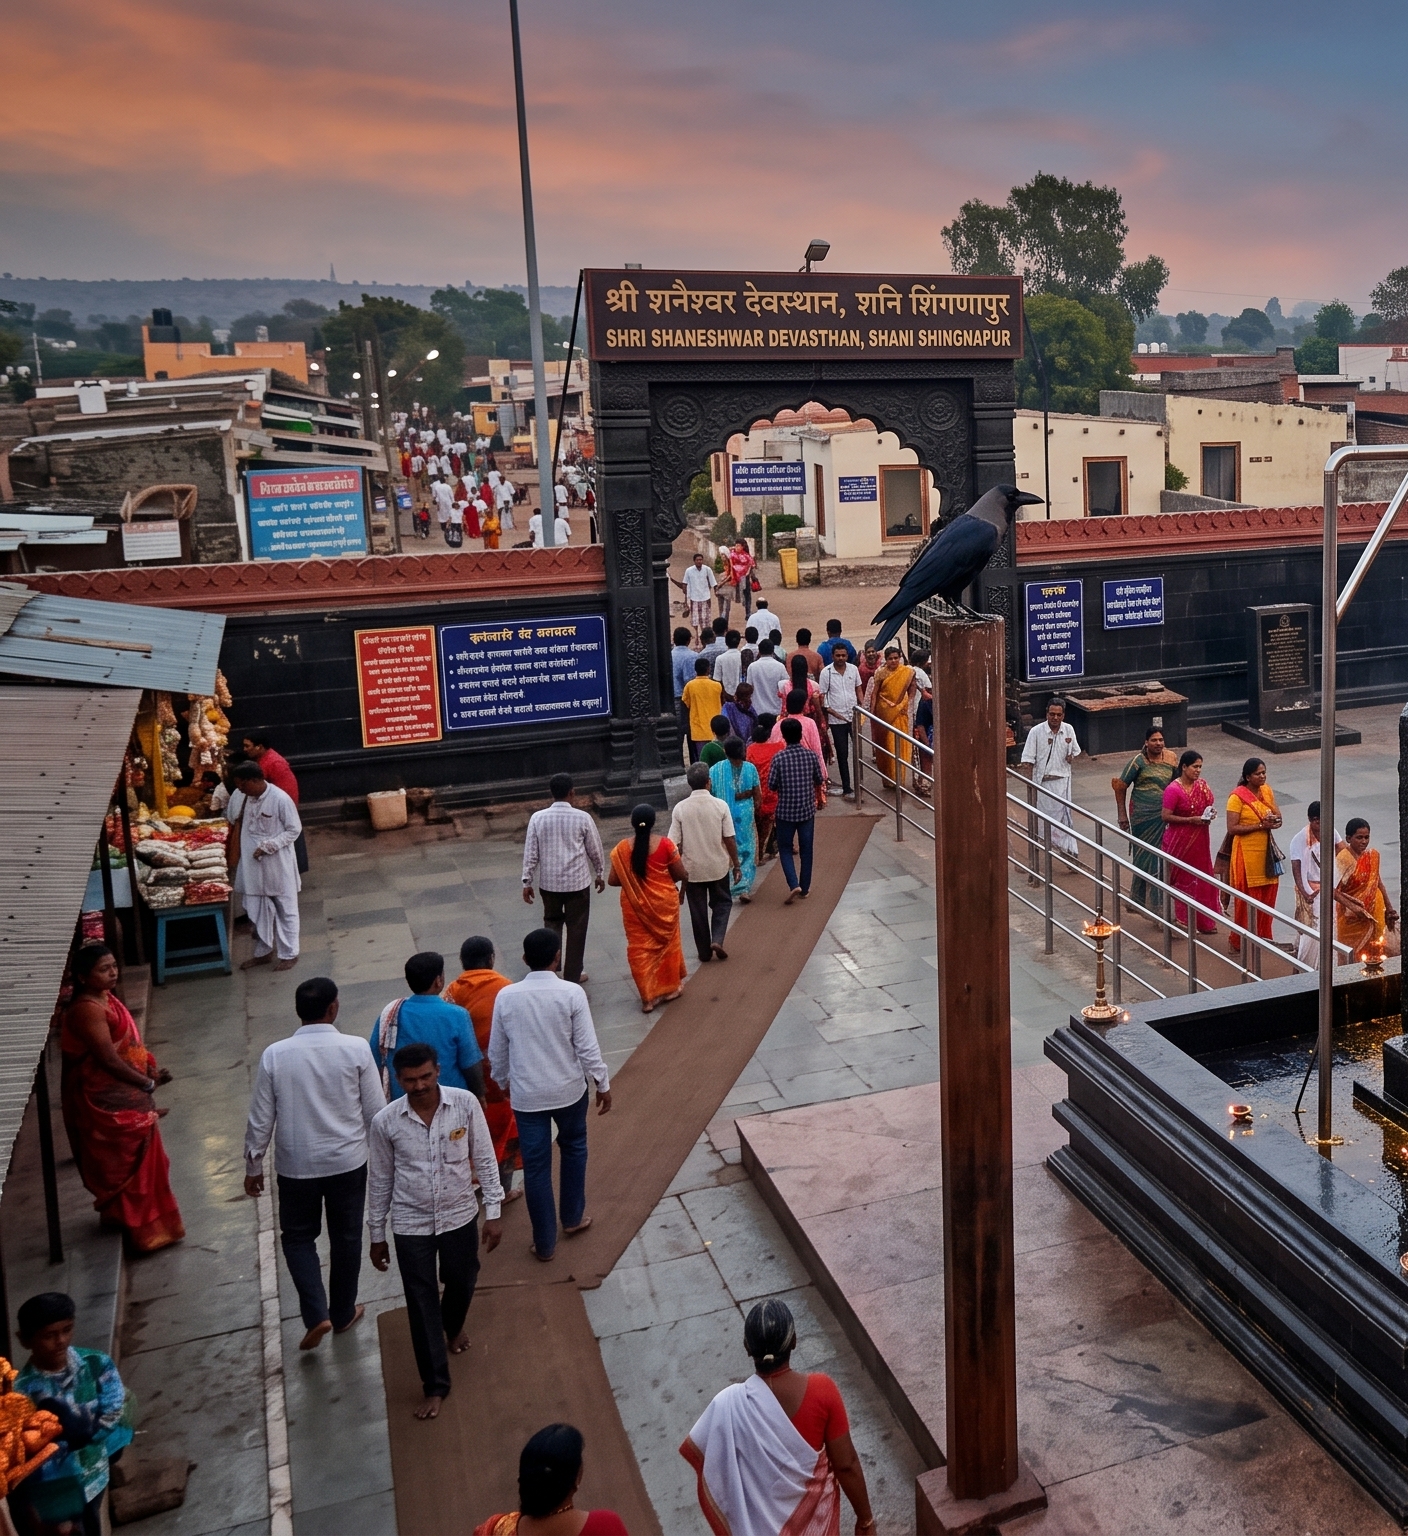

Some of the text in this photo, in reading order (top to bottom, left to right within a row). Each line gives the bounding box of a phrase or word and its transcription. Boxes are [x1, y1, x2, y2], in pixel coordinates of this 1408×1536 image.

[606, 279, 1010, 325] श्री शनैश्वर देवस्थान, शनि शिंगणापुर
[606, 328, 1011, 349] SHRI SHANESHWAR DEVASTHAN, SHANI SHINGNAPUR
